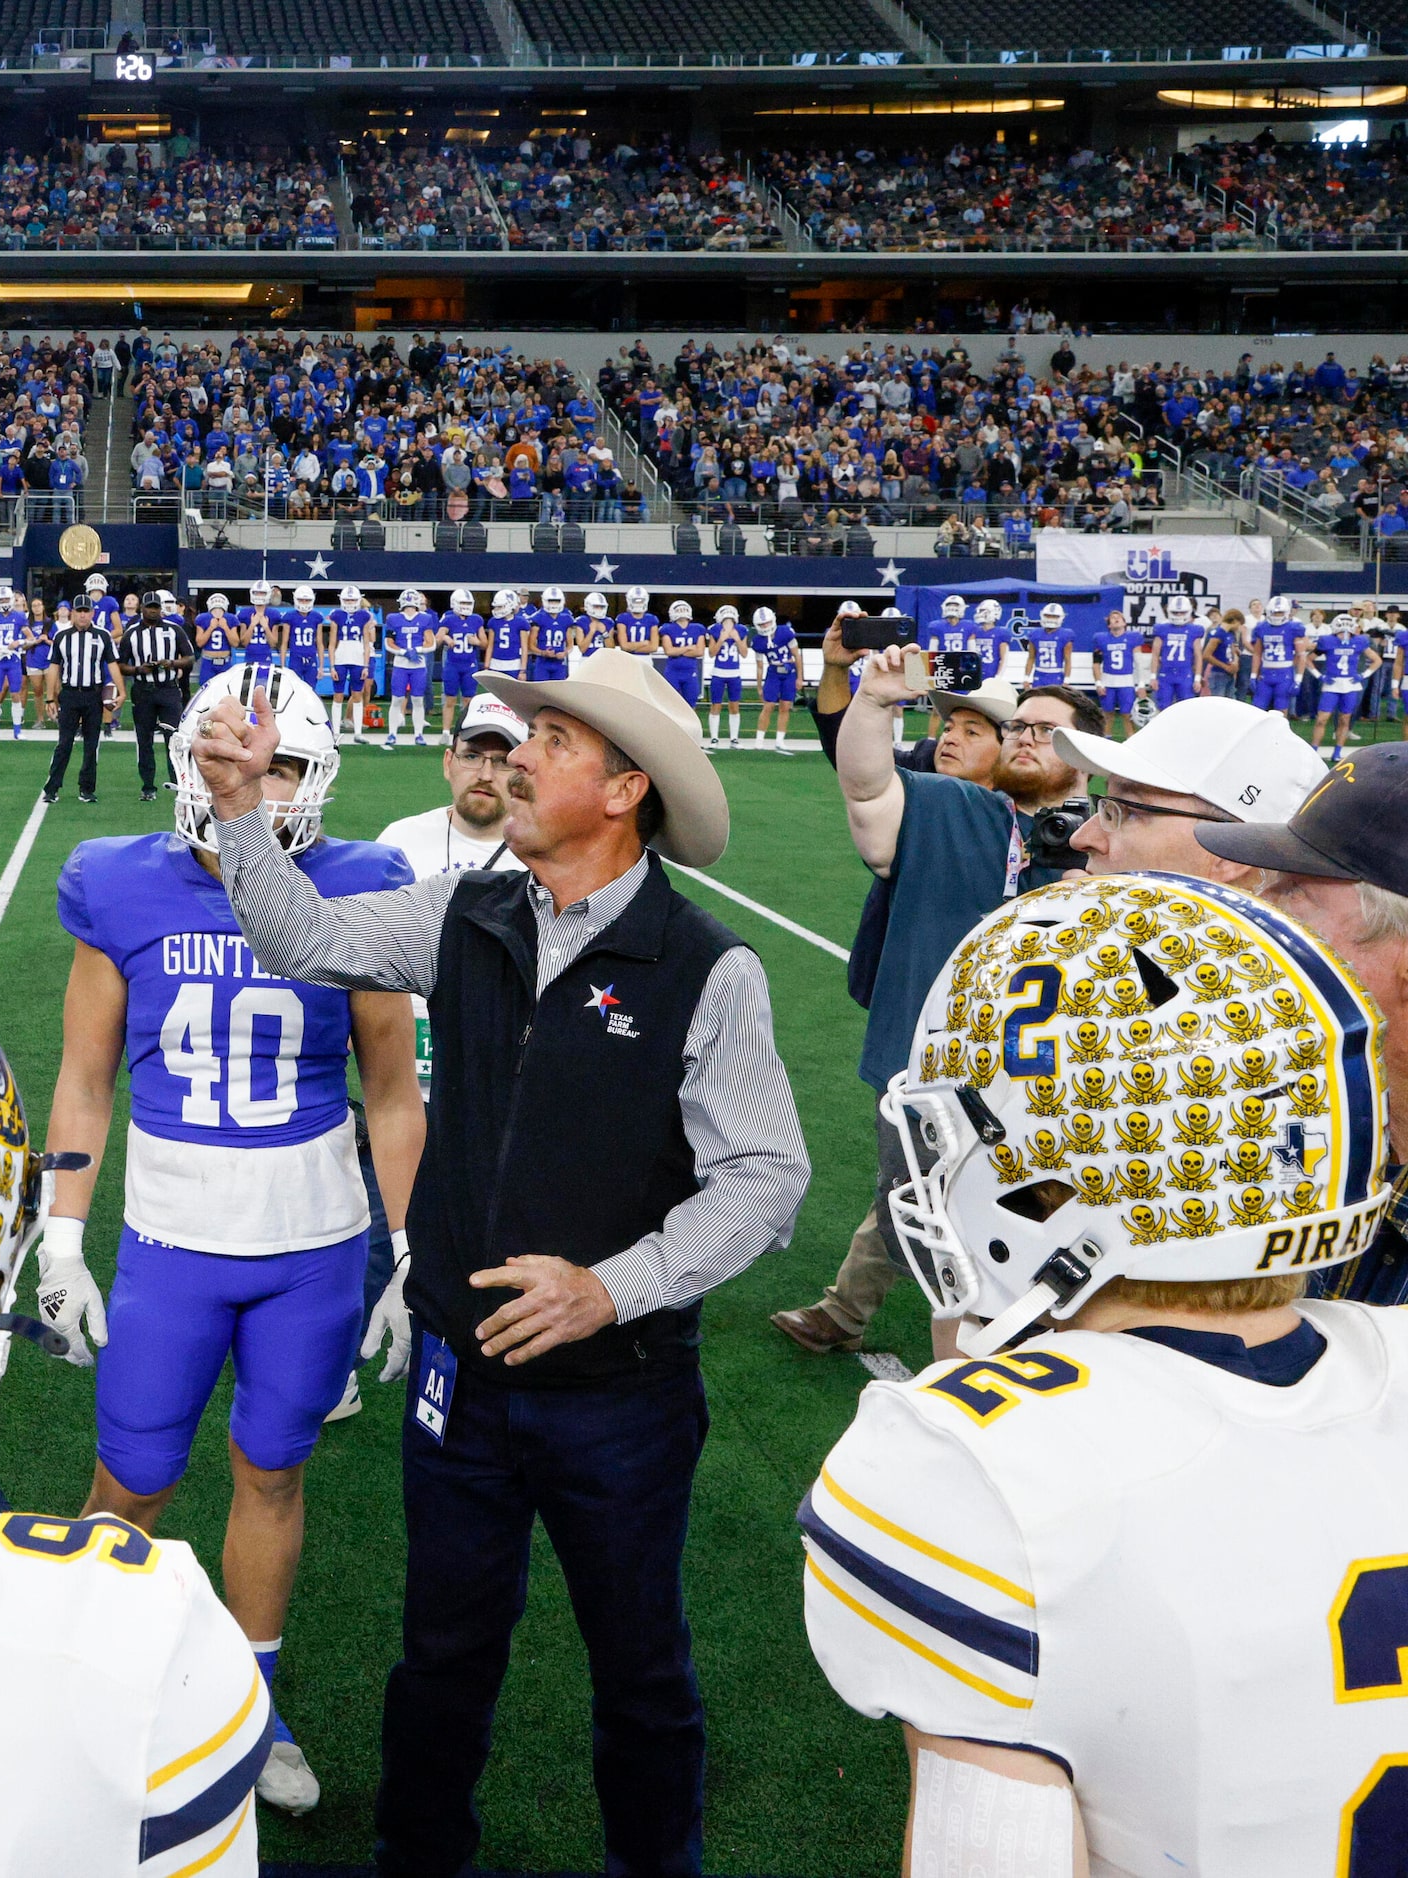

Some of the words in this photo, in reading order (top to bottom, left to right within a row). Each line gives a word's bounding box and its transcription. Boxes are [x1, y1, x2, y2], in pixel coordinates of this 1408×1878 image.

[211, 630, 222, 650] 9
[295, 627, 313, 646] 10
[499, 628, 511, 649] 5
[1039, 647, 1058, 667] 21
[1111, 650, 1123, 669] 9
[1167, 640, 1185, 661] 71
[1336, 655, 1348, 675] 4
[162, 933, 290, 980] GUNT
[608, 1019, 630, 1029] FARM
[609, 1012, 634, 1024] TEXAS
[1003, 961, 1067, 1081] 2
[160, 983, 304, 1128] 40
[1256, 1198, 1389, 1271] PIRAT
[41, 1289, 67, 1305] adidas
[425, 1367, 445, 1407] AA
